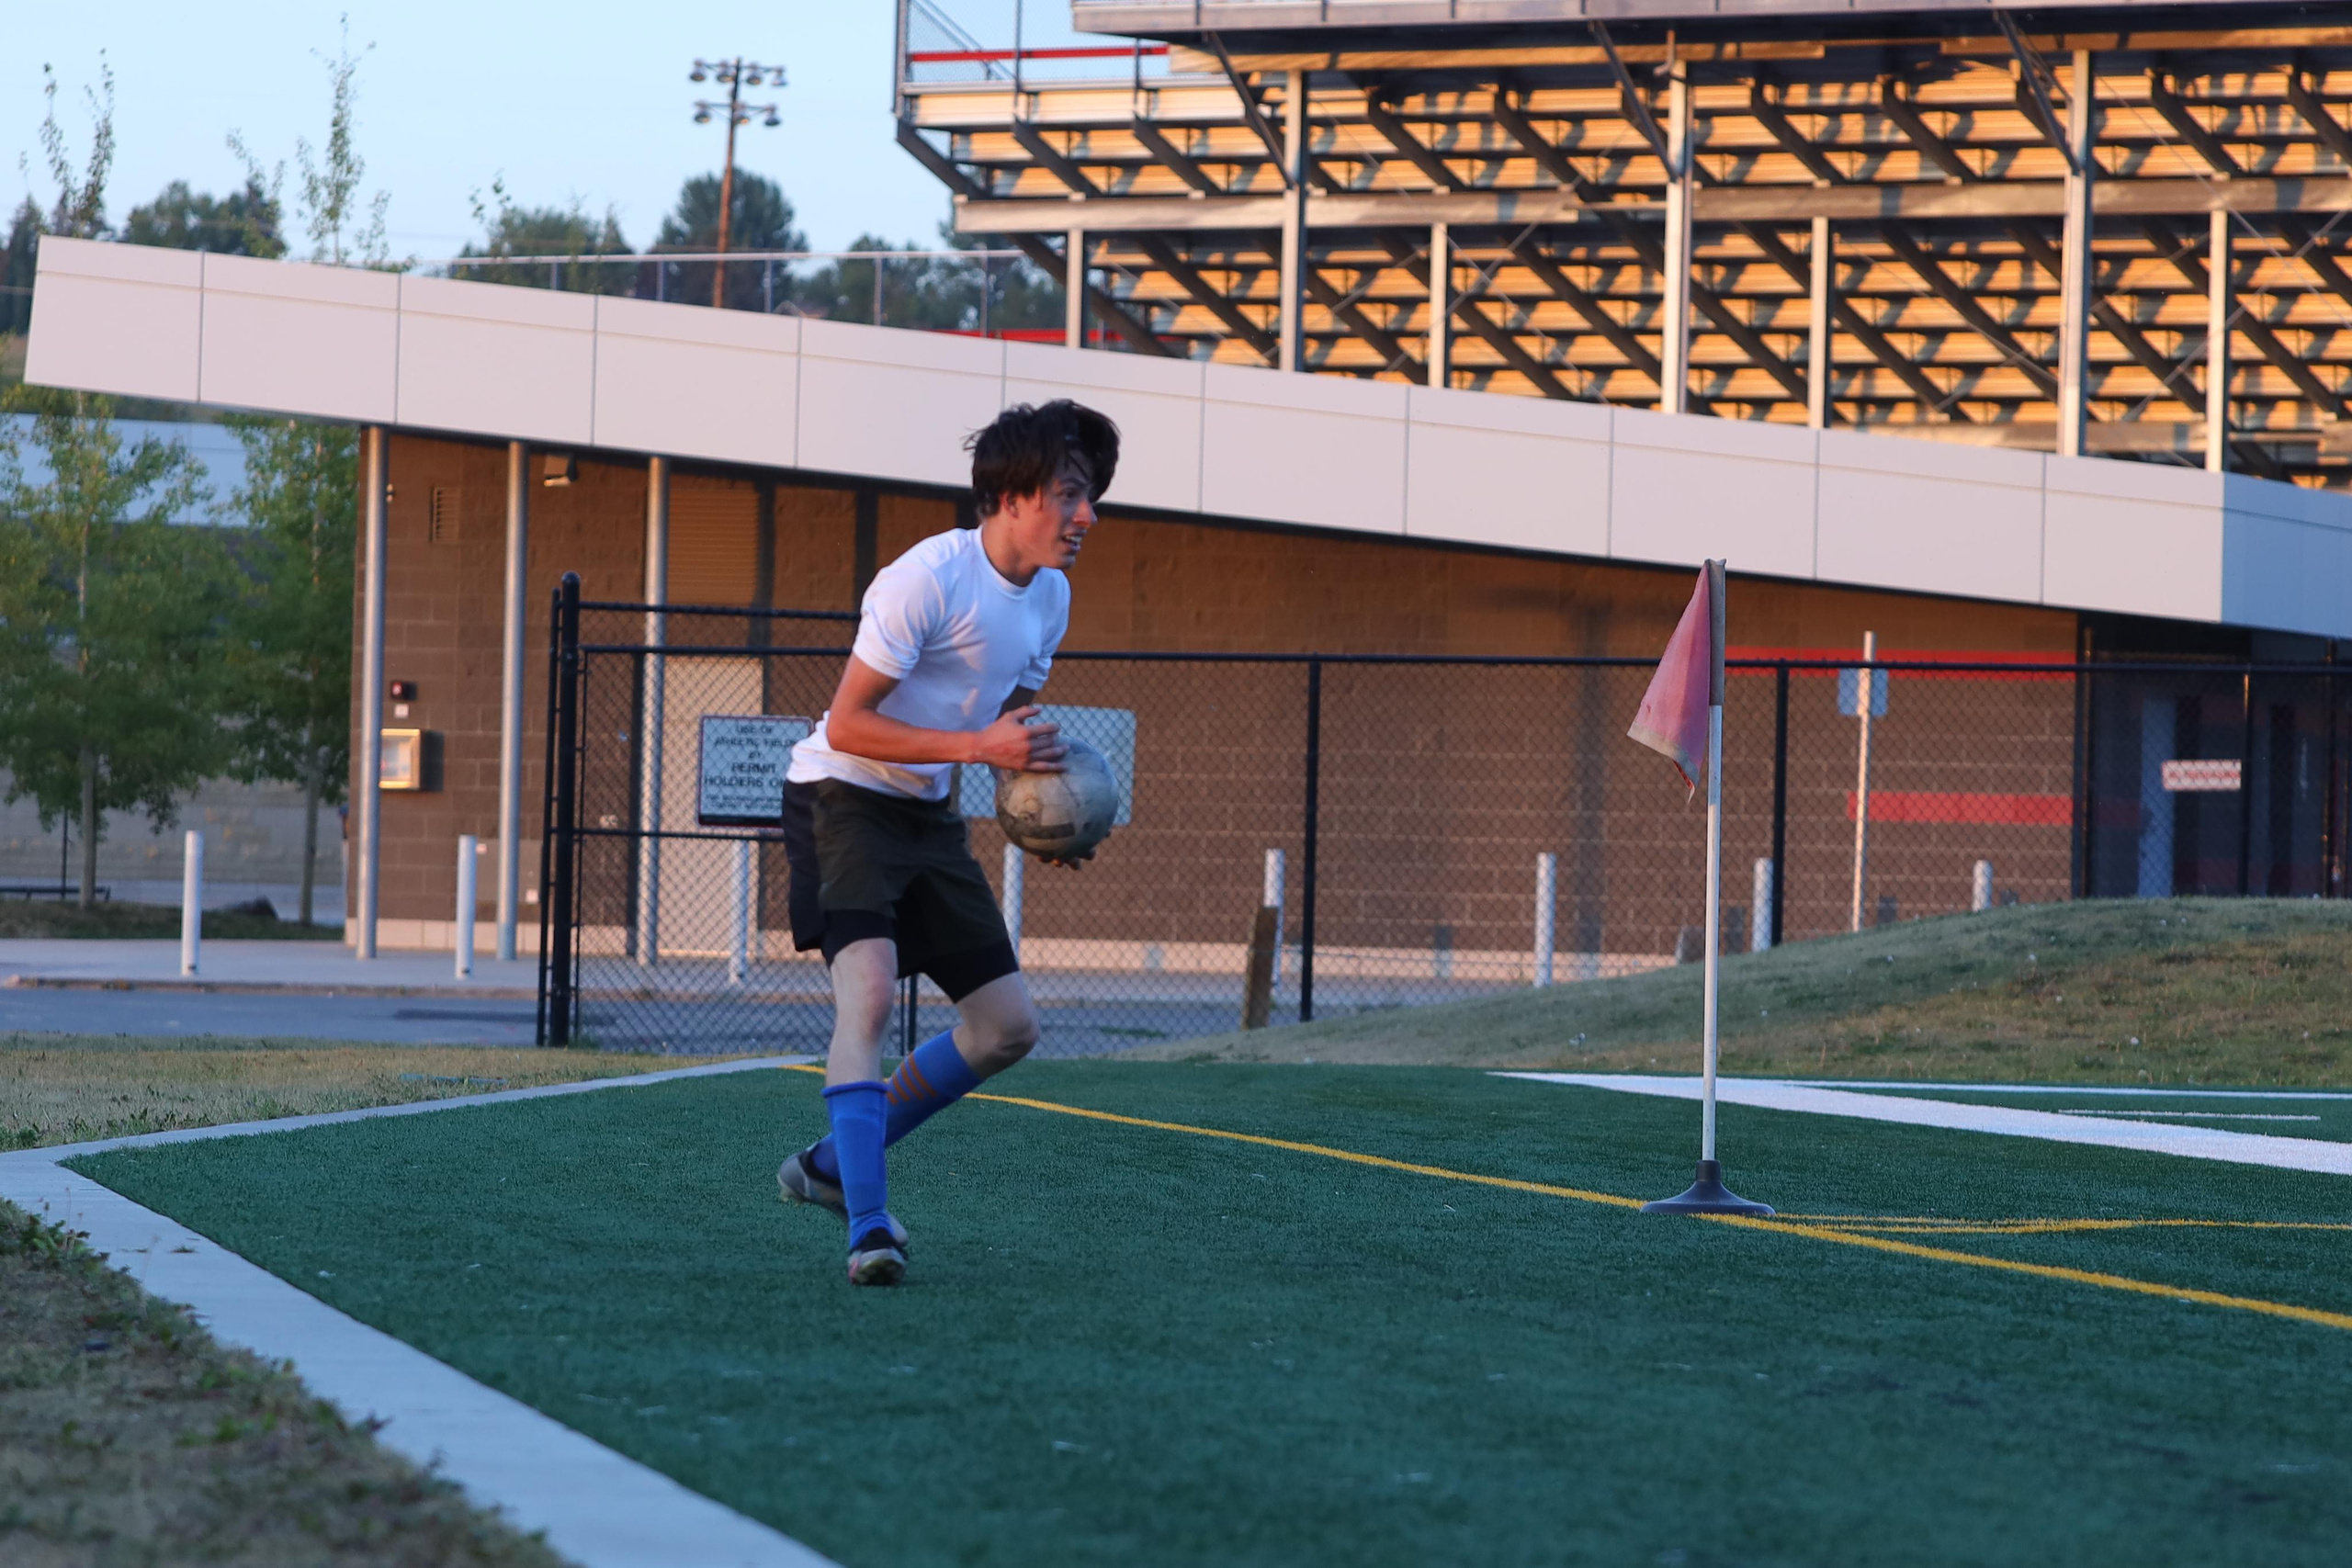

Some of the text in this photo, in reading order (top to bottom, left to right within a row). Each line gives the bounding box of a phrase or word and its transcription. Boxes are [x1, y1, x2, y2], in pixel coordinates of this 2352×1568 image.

[736, 725, 755, 734] USE
[731, 762, 777, 773] PERMIT
[704, 775, 764, 787] HOLDERS
